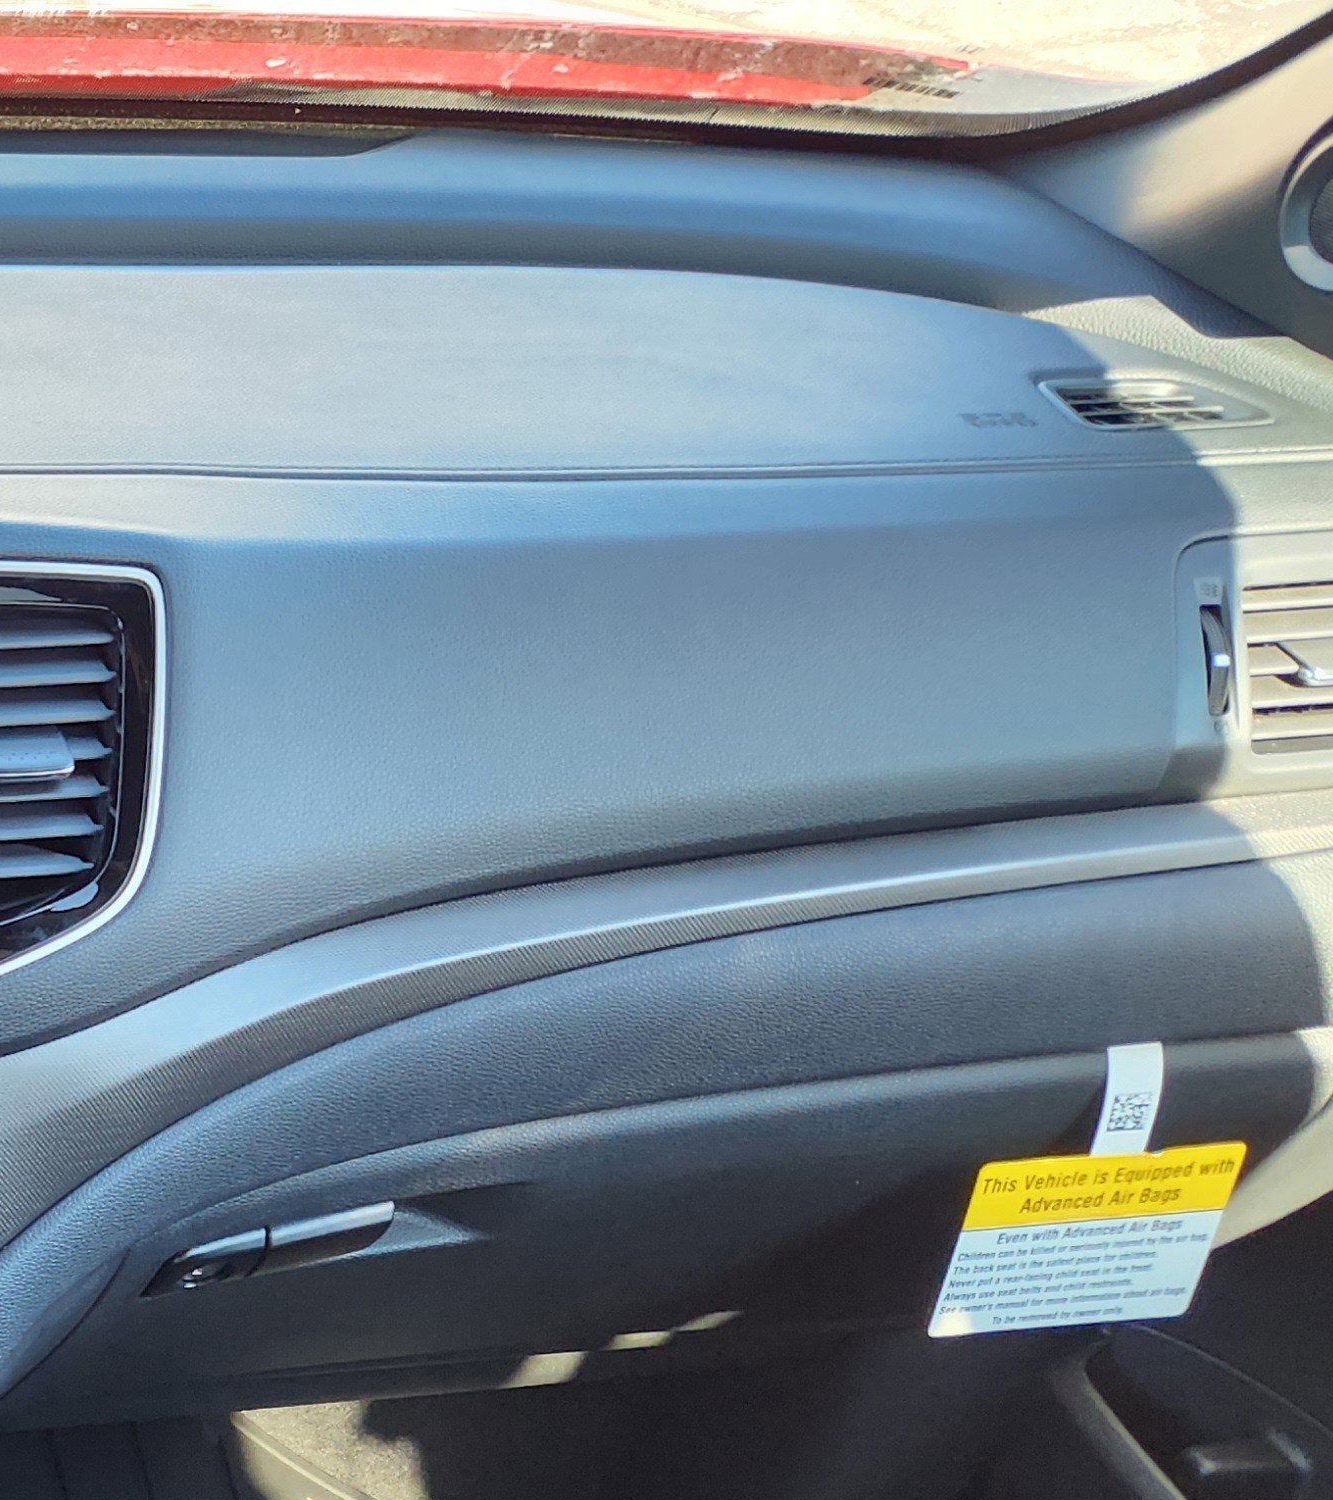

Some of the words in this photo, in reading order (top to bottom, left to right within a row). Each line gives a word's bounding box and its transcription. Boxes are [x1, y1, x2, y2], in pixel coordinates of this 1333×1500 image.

[983, 1178, 1018, 1195] This
[1024, 1170, 1087, 1191] Vehicle
[1093, 1169, 1108, 1186] is
[1114, 1161, 1193, 1185] Equipped
[1199, 1159, 1235, 1176] with
[1019, 1192, 1104, 1214] Advanced
[1107, 1190, 1134, 1206] Air
[1139, 1186, 1182, 1204] Bags
[996, 1232, 1028, 1245] Even
[1032, 1229, 1059, 1241] with
[1062, 1223, 1126, 1238] Advanced
[1128, 1221, 1148, 1233] Air
[1150, 1219, 1184, 1232] Bags
